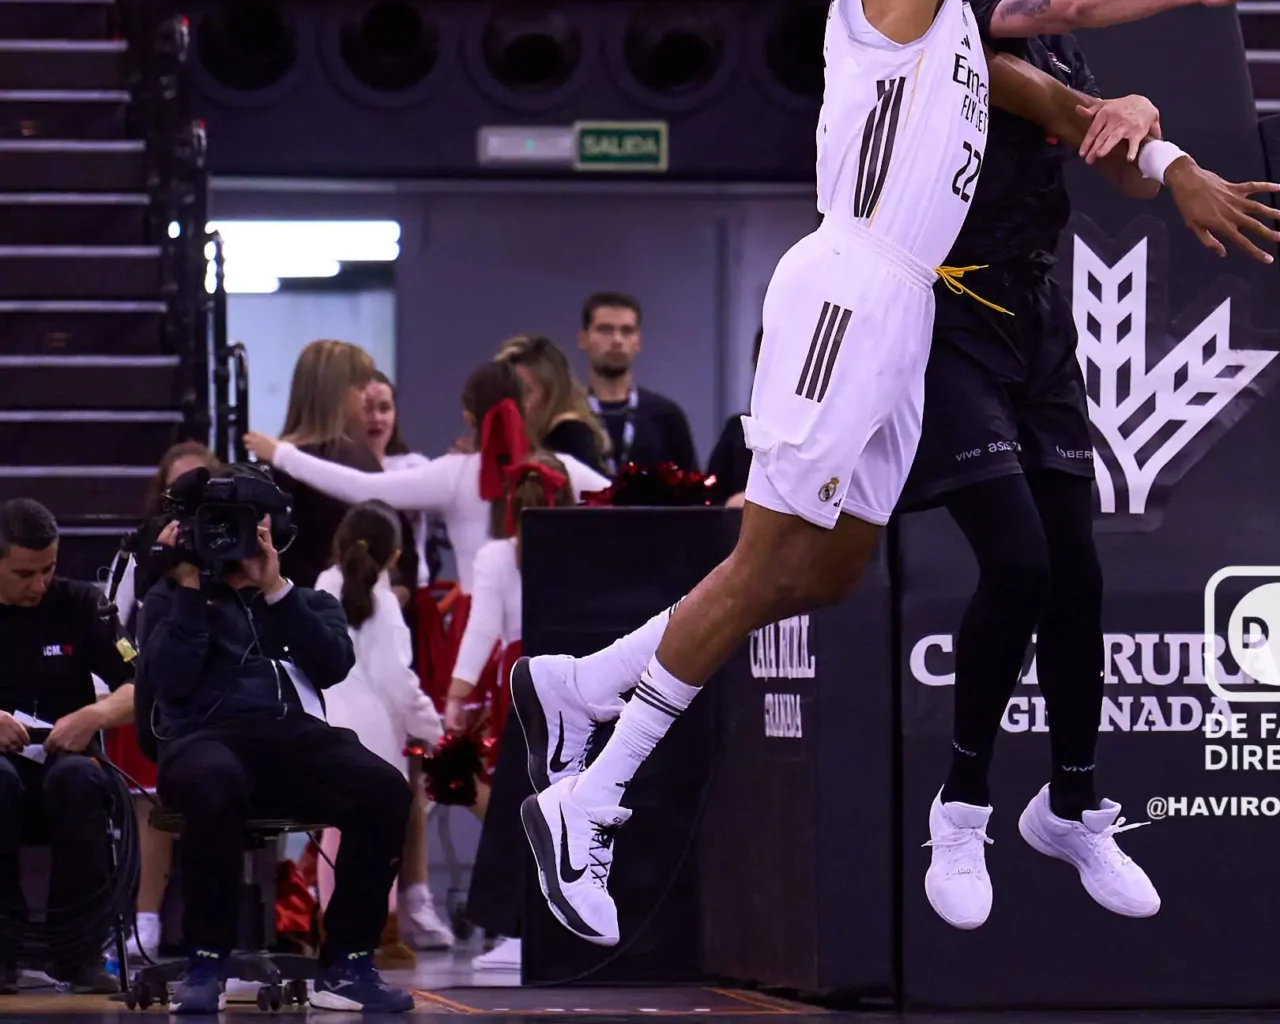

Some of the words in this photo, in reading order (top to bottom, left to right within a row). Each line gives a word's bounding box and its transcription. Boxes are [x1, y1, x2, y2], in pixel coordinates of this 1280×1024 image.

[952, 140, 982, 204] 22
[1066, 450, 1094, 459] BER
[999, 696, 1241, 732] GNADA
